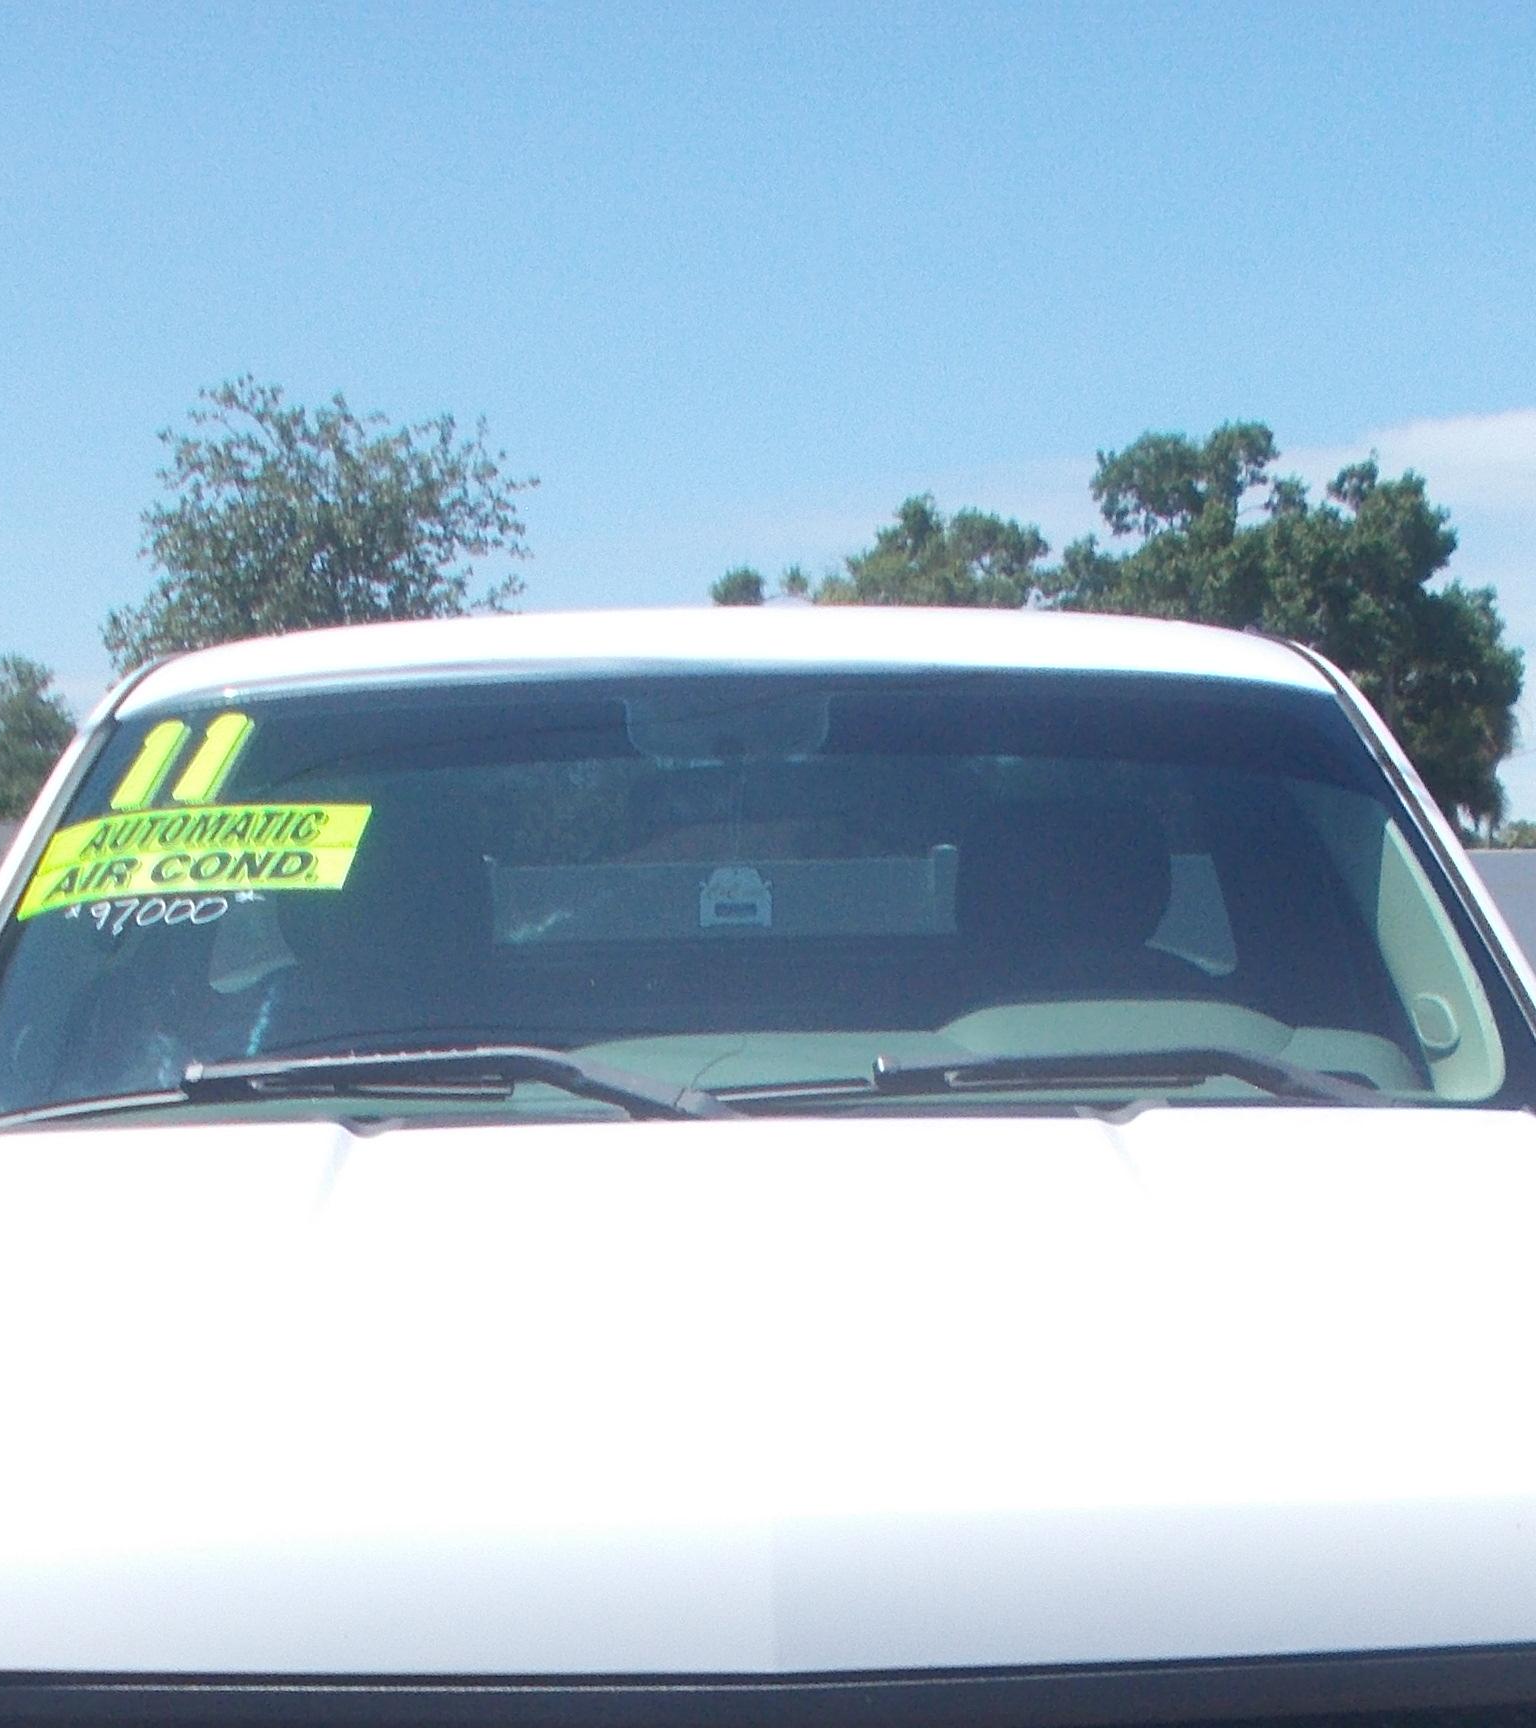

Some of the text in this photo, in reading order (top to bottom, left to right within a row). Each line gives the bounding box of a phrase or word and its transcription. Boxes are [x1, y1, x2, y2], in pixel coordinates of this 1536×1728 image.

[110, 711, 255, 809] 11
[79, 808, 330, 859] AUTOMATIC
[44, 850, 319, 905] AIR COND.
